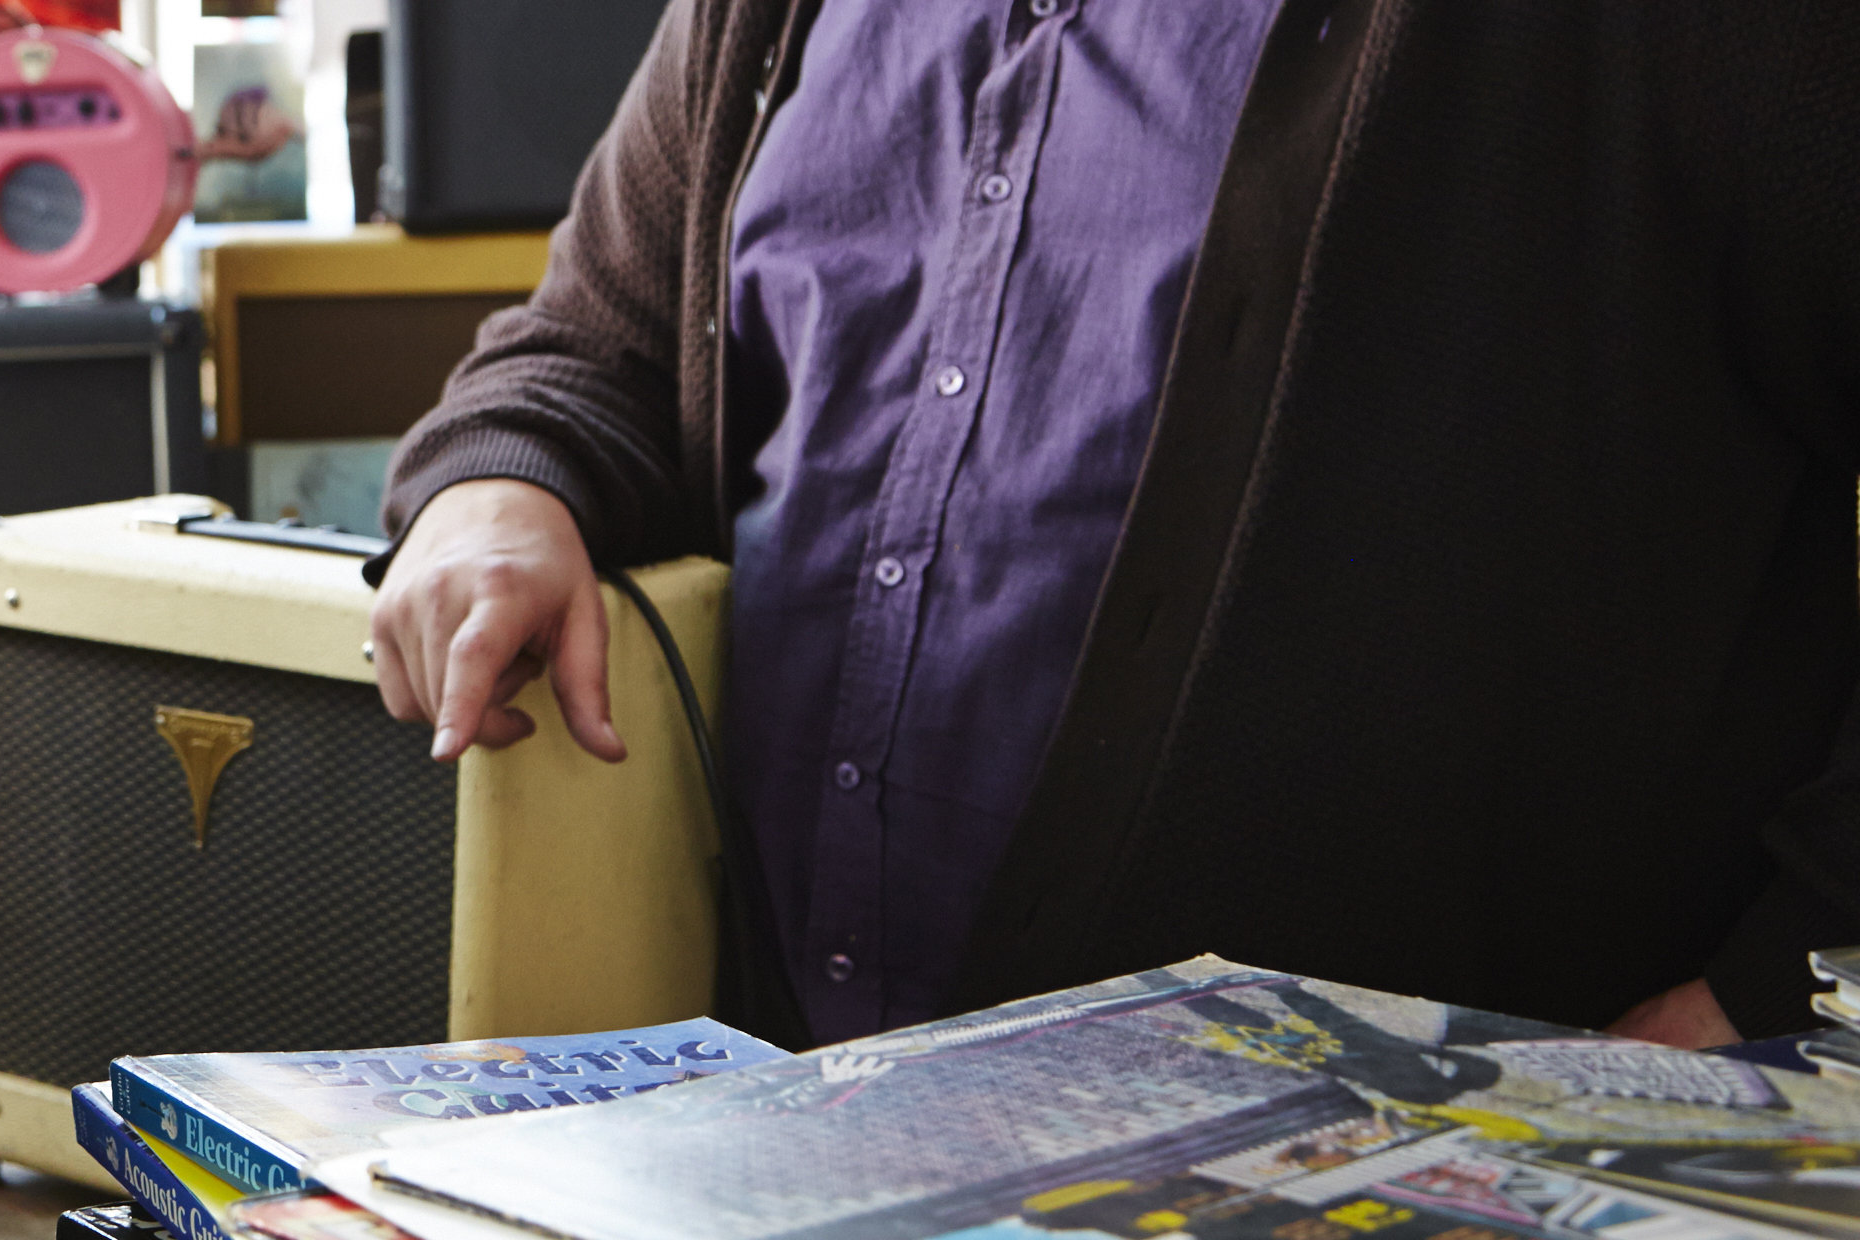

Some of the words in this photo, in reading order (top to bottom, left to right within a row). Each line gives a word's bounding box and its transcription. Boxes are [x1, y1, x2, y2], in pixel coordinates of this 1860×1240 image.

[298, 1039, 733, 1087] Electric
[124, 1147, 187, 1235] Acoustic
[184, 1112, 261, 1191] Electric
